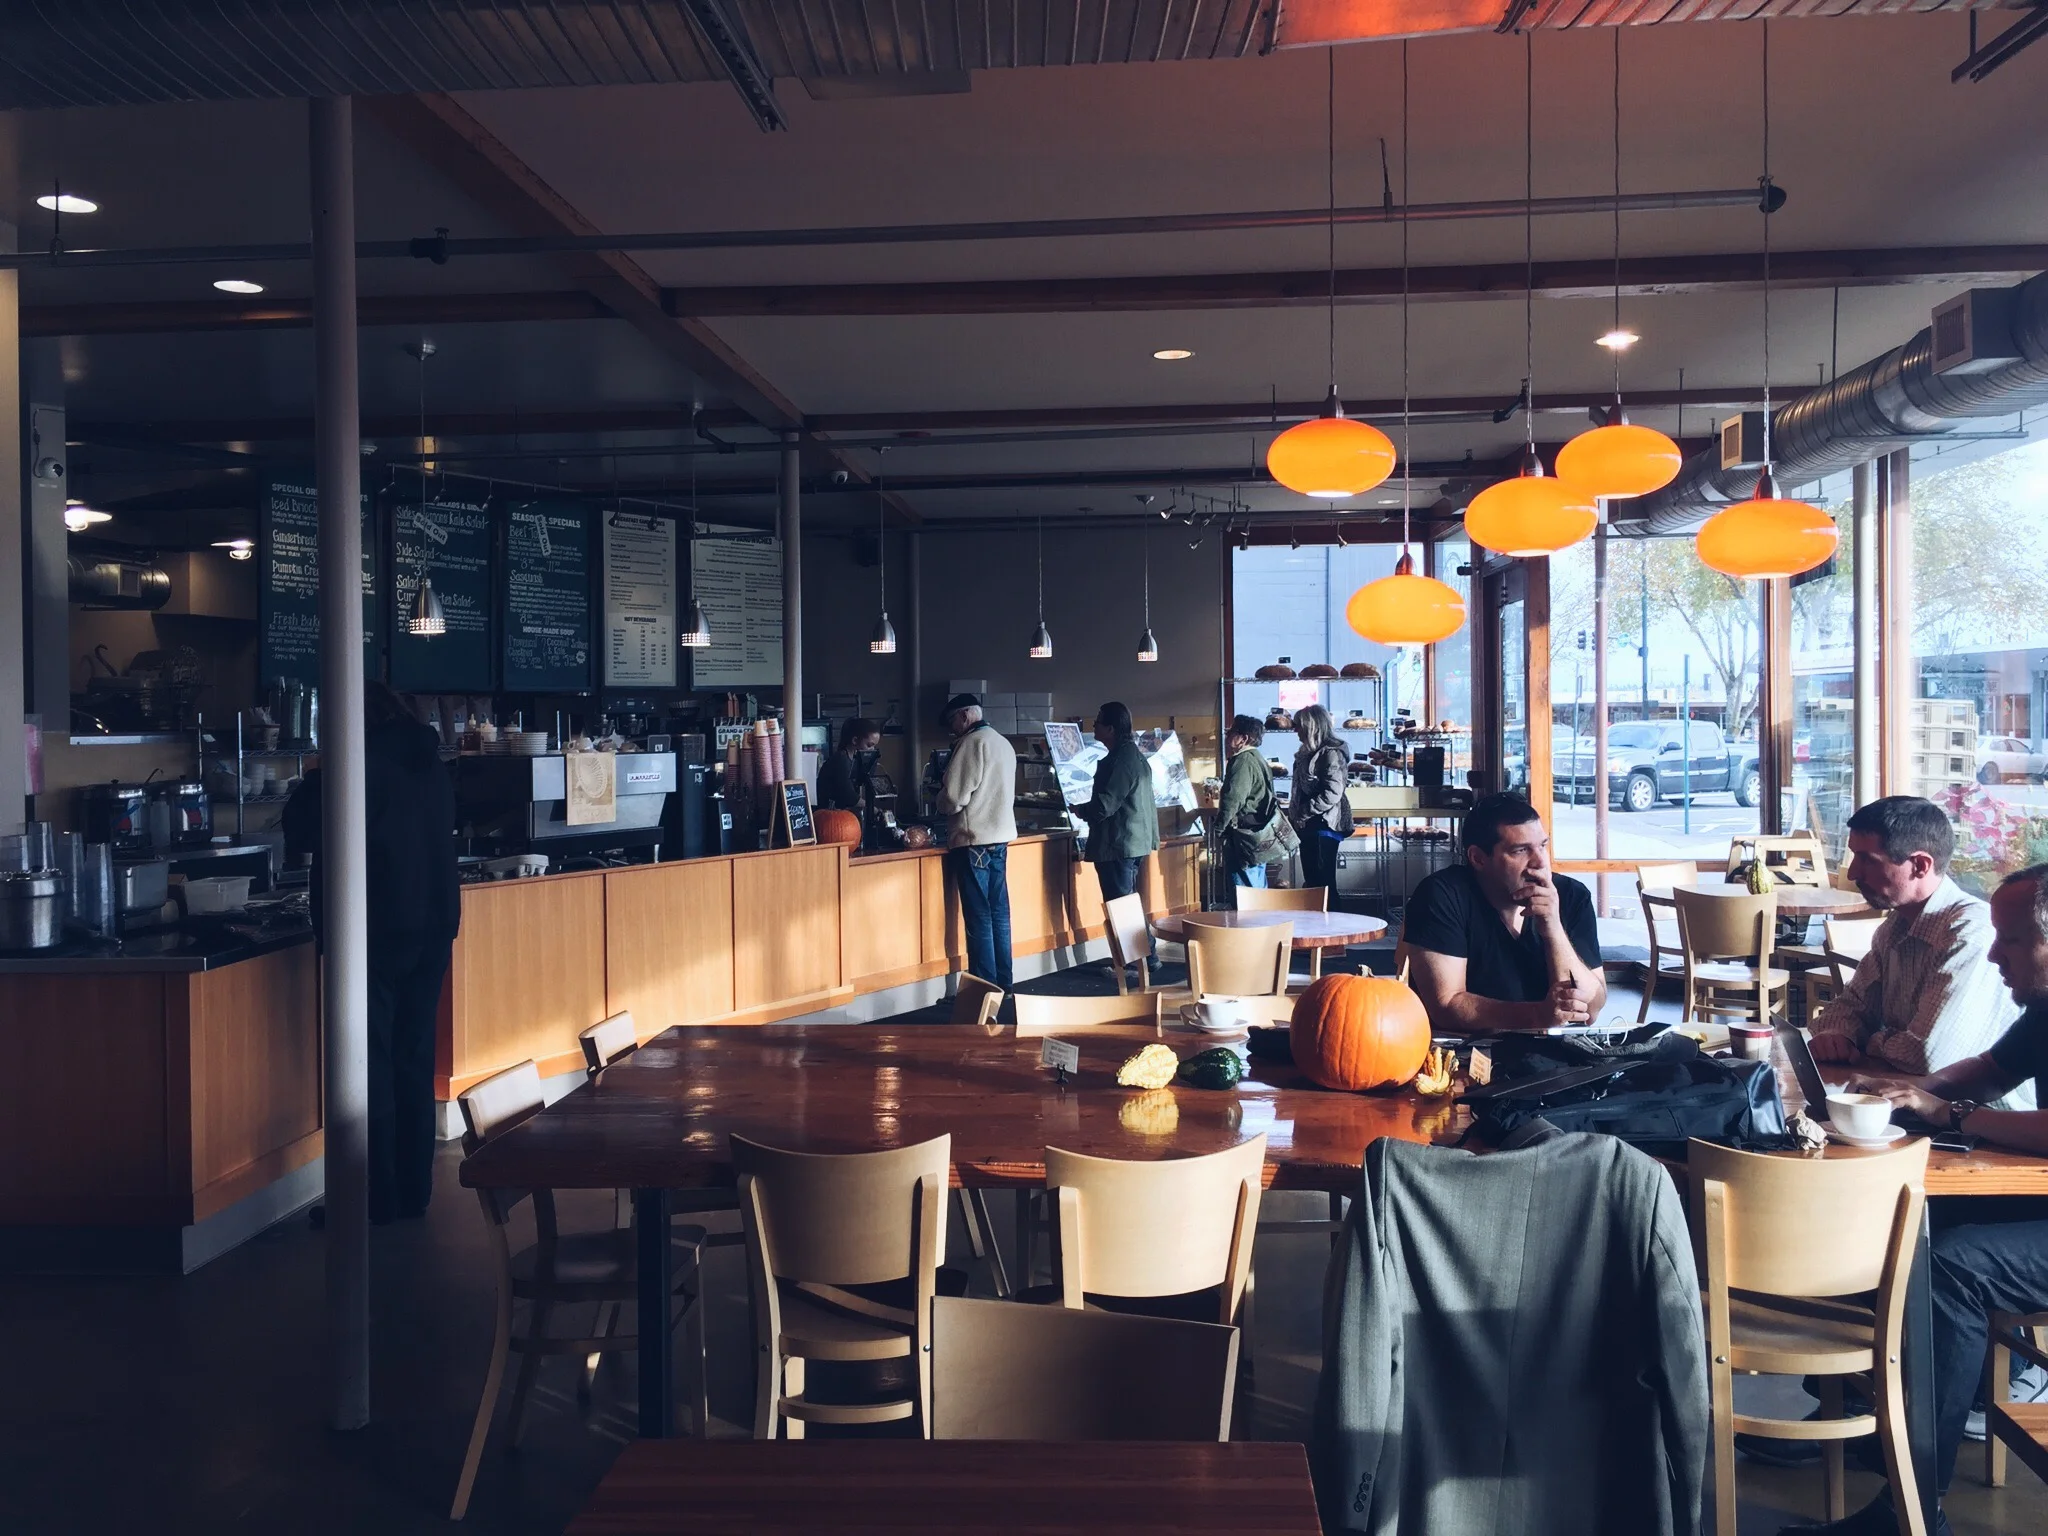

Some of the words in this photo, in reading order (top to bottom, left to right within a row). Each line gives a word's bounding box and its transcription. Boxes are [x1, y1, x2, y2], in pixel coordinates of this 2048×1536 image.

[271, 483, 304, 495] SPECIAL
[548, 517, 581, 528] SPECIALS
[271, 560, 303, 576] Pumpkin
[272, 611, 299, 626] Fresh
